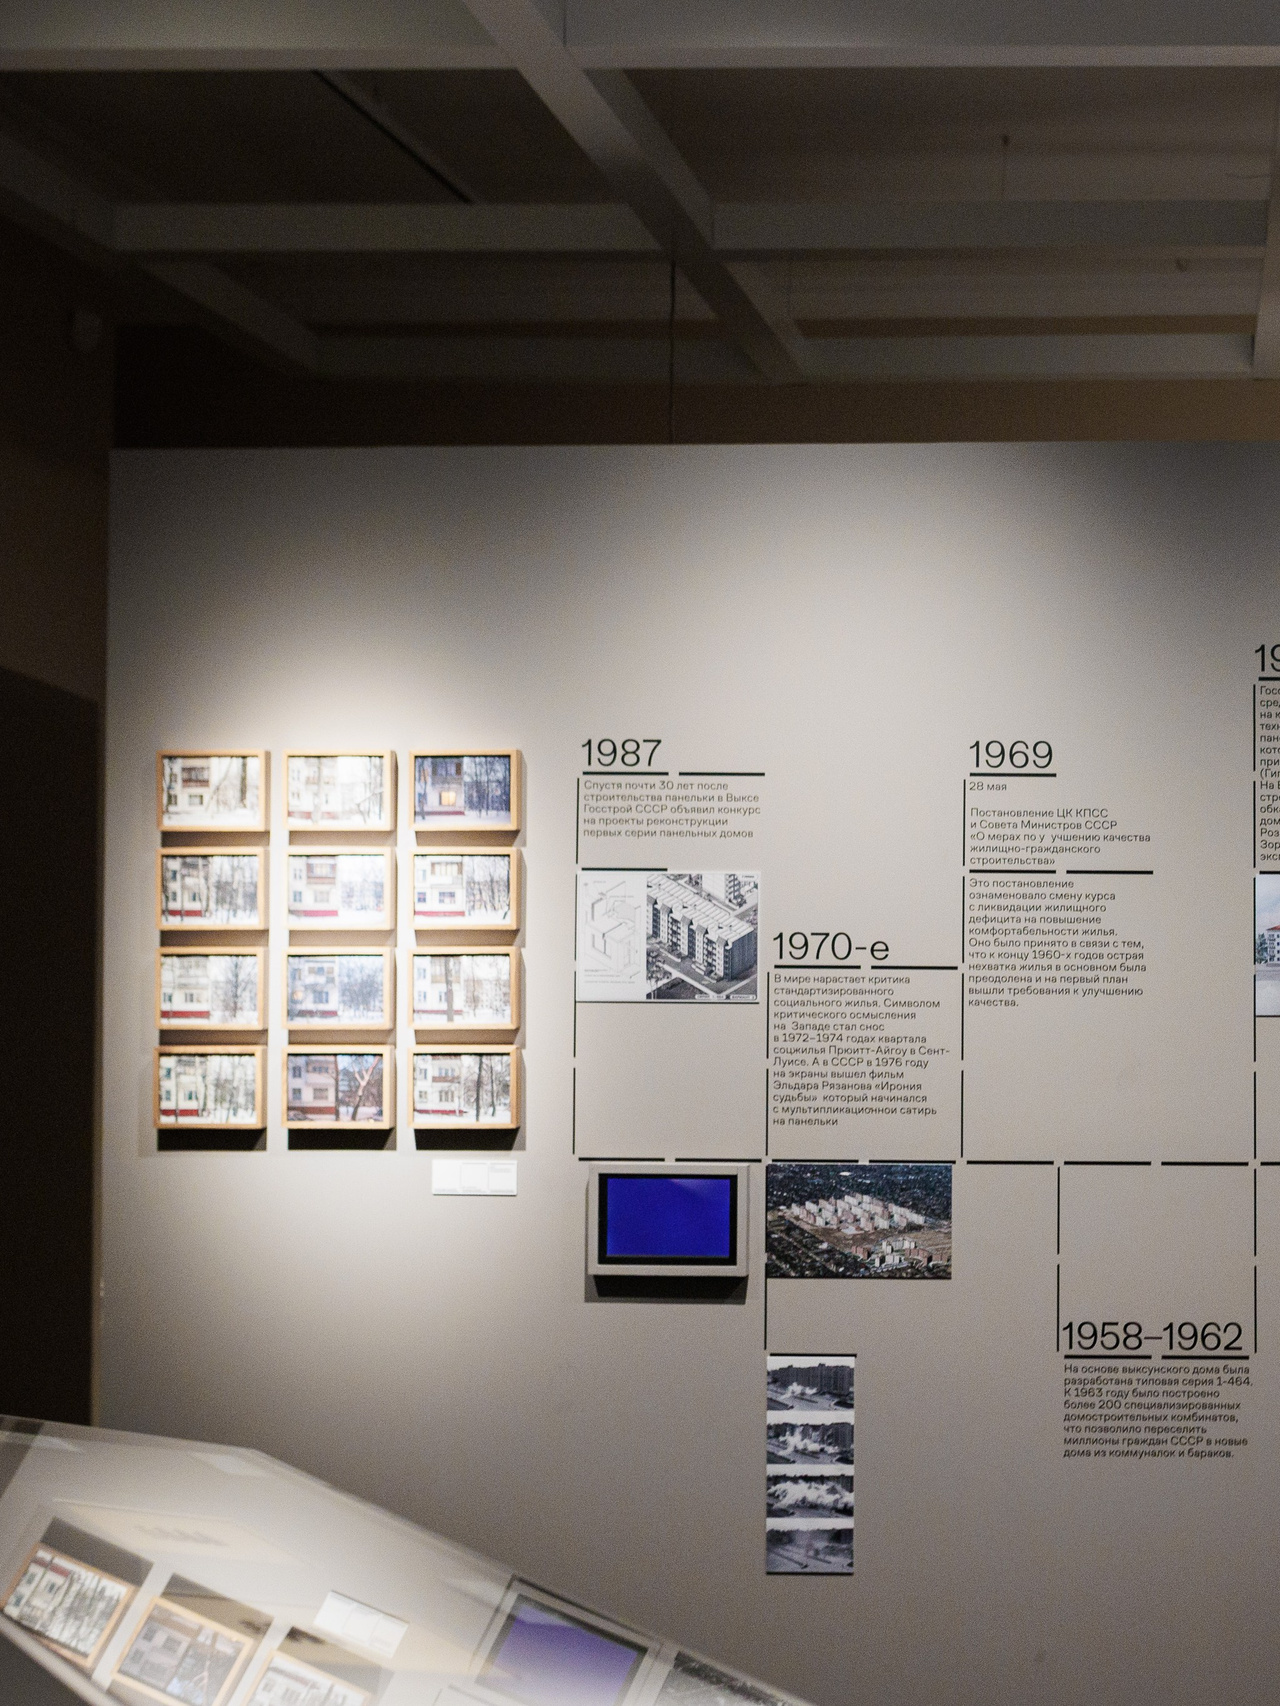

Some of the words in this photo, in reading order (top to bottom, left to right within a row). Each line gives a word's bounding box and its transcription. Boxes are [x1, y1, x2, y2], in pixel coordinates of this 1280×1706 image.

[1259, 711, 1273, 720] на
[581, 738, 662, 767] 1987
[969, 740, 1053, 769] 1969
[583, 780, 622, 792] Спустя
[624, 782, 656, 791] почти
[658, 780, 674, 791] 30
[676, 782, 694, 791] лет
[696, 782, 728, 791] после
[968, 780, 984, 791] 28
[986, 782, 1007, 791] мая
[583, 794, 662, 804] строительства
[664, 794, 715, 803] панельки
[717, 794, 723, 803] в
[725, 792, 759, 803] Выксе
[583, 804, 633, 816] Госстрой
[634, 804, 668, 814] СССР
[669, 804, 715, 815] объявил
[717, 806, 761, 816] конкурс
[970, 807, 1054, 818] Постановление
[1056, 808, 1073, 820] ЦК
[1075, 808, 1108, 818] КПСС
[582, 817, 596, 826] на
[598, 817, 644, 827] проекты
[646, 817, 728, 827] реконструкции
[970, 821, 977, 830] и
[979, 819, 1018, 830] Совета
[1020, 819, 1082, 832] Министров
[1084, 819, 1117, 830] СССР
[582, 829, 622, 839] первых
[624, 829, 657, 839] серии
[659, 829, 717, 838] панельных
[718, 829, 753, 840] домов
[969, 845, 1101, 855] жилищно-гражданского
[969, 857, 1055, 867] строительства»
[969, 877, 990, 888] Это
[991, 880, 1074, 888] постановление
[968, 891, 1047, 900] ознаменовало
[1048, 892, 1083, 902] смену
[1084, 892, 1116, 902] курса
[968, 903, 975, 912] с
[977, 903, 1042, 914] ликвидации
[1044, 903, 1106, 914] жилищного
[967, 913, 1021, 925] дефицита
[1024, 915, 1037, 924] на
[1039, 915, 1101, 924] повышение
[968, 925, 1079, 937] комфортабельности
[1081, 927, 1117, 936] жилья.
[773, 931, 890, 961] 1970-е
[773, 973, 781, 984] В
[783, 975, 811, 985] мире
[812, 975, 866, 986] нарастает
[868, 976, 910, 986] критика
[773, 987, 894, 997] стандартизированного
[773, 999, 842, 1009] социального
[844, 999, 880, 1008] жилья.
[883, 997, 940, 1008] Символом
[773, 1011, 847, 1021] критического
[849, 1011, 916, 1020] осмысления
[1062, 1321, 1243, 1352] 1958–1962
[1063, 1399, 1096, 1410] более
[1097, 1399, 1122, 1410] 200
[1123, 1401, 1241, 1412] специализированных
[1062, 1413, 1168, 1424] домостроительных
[1170, 1411, 1239, 1424] комбинатов,
